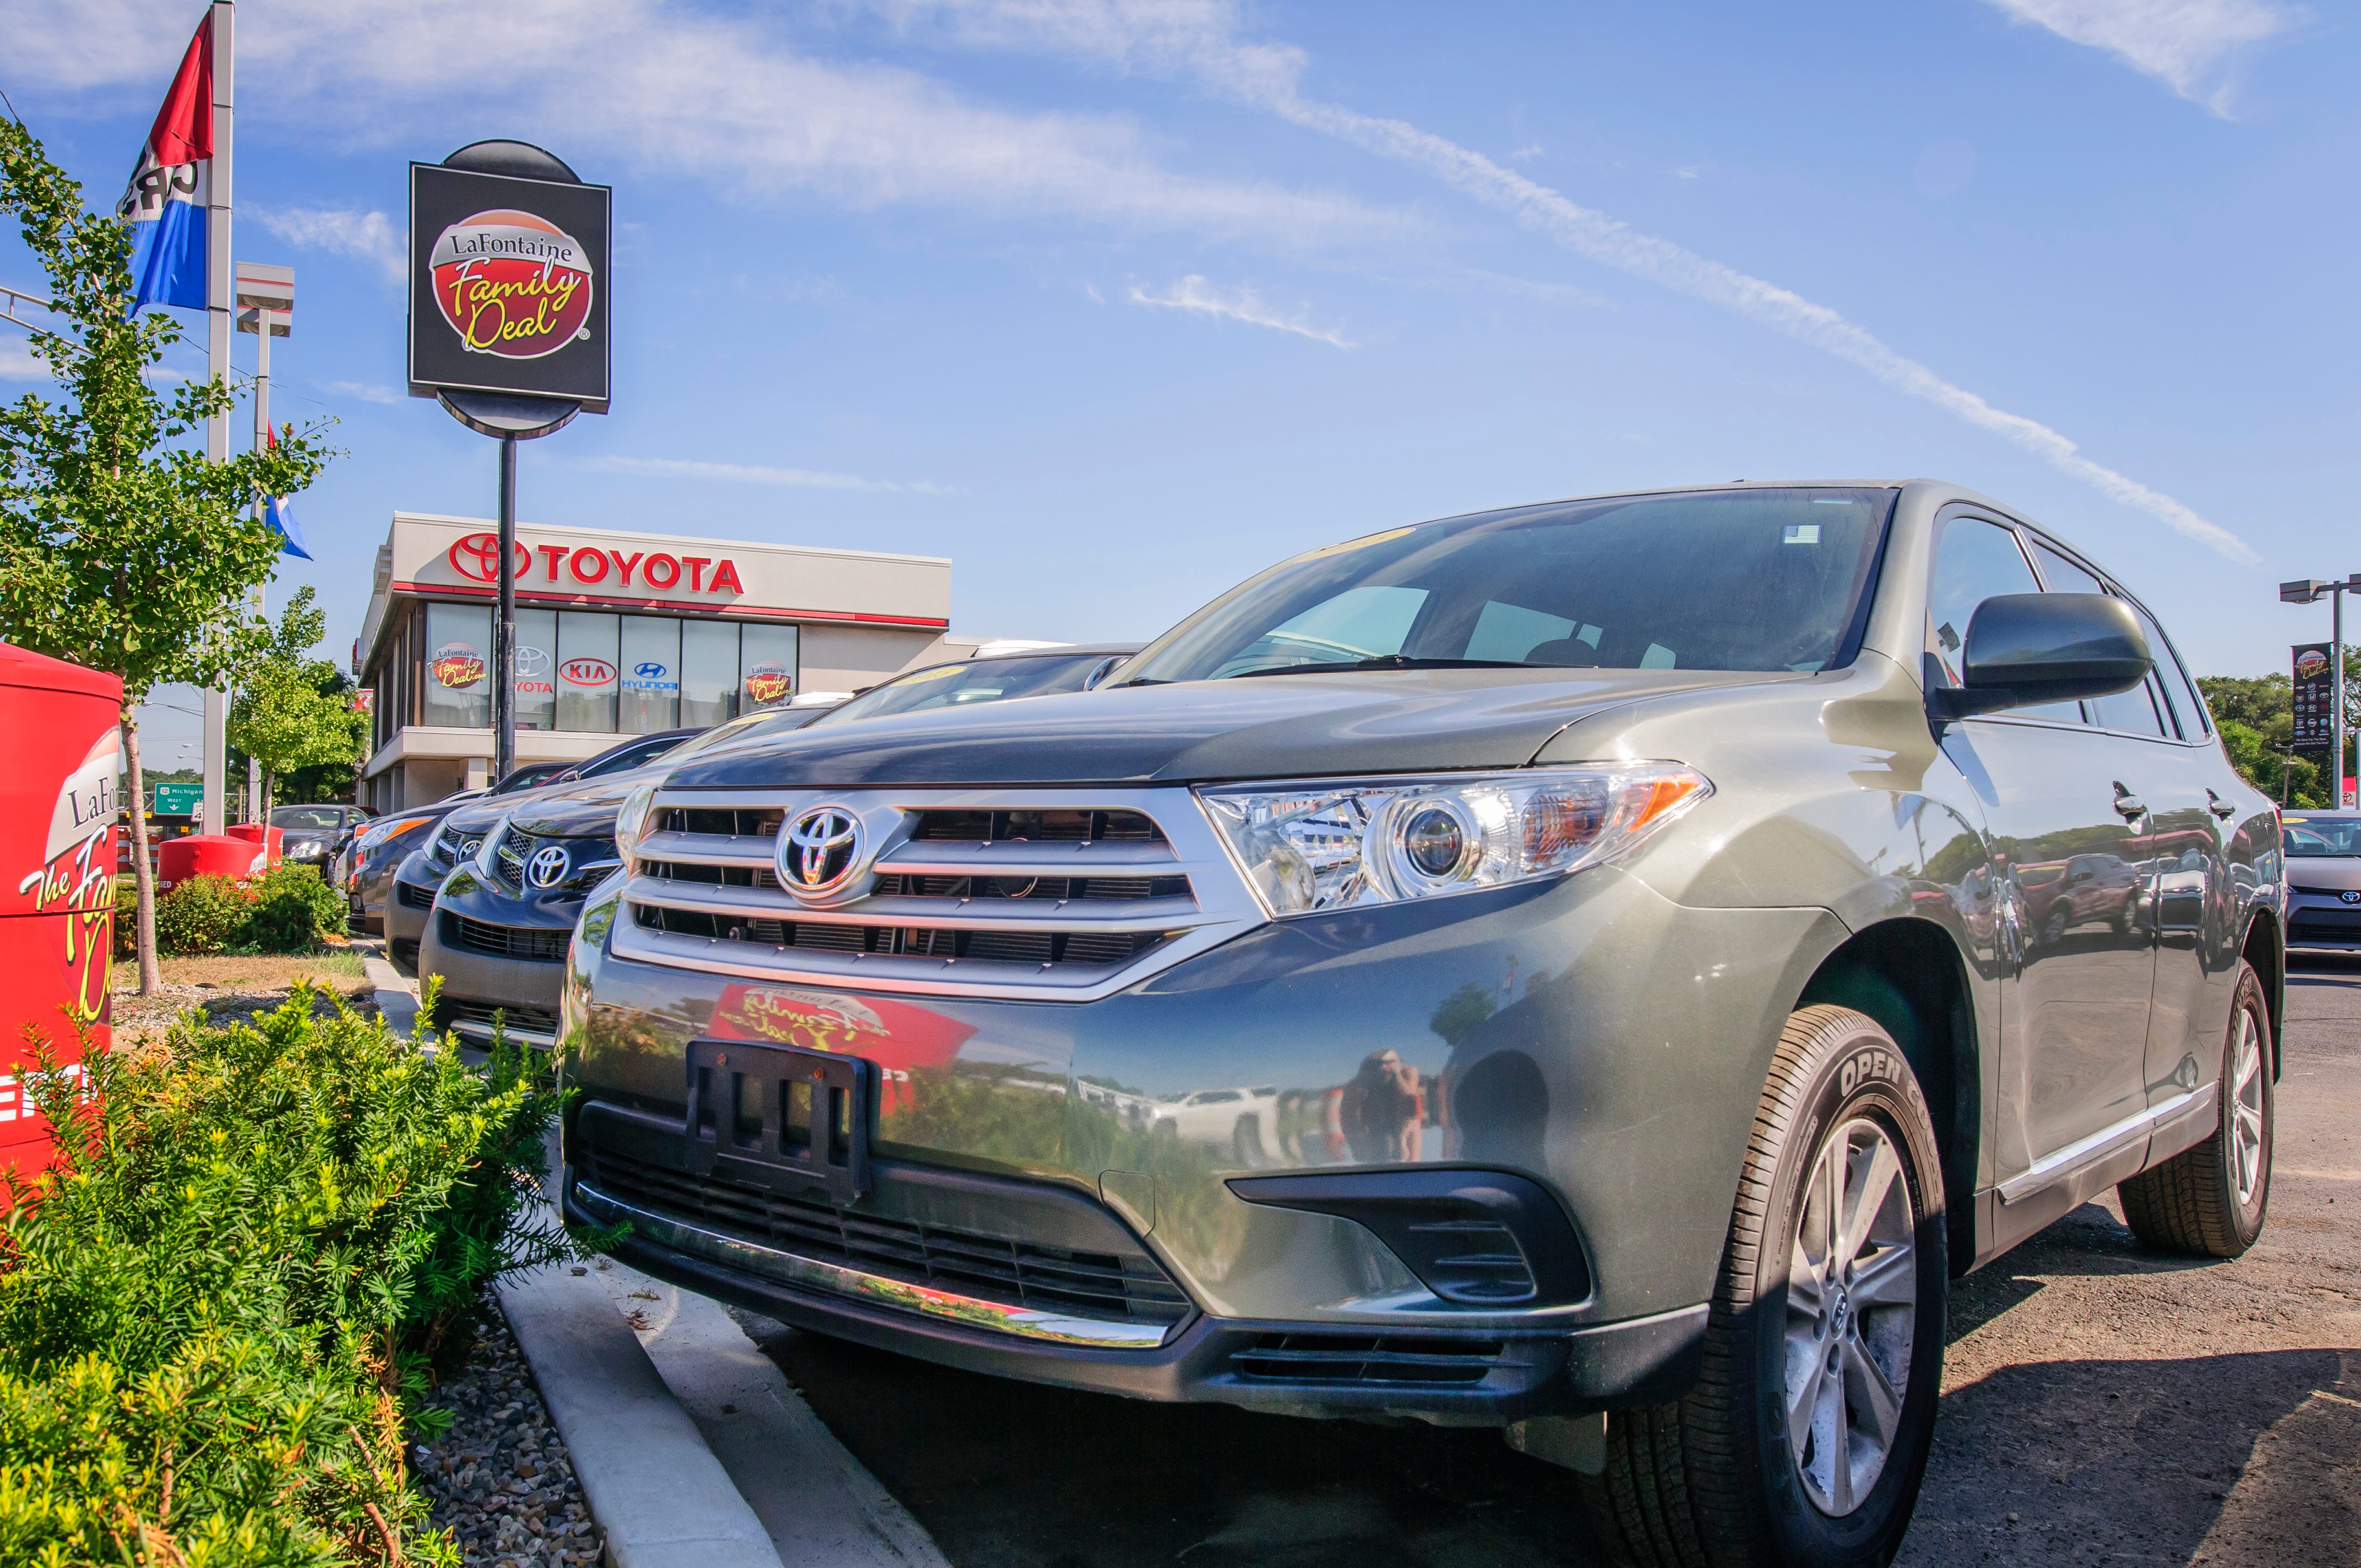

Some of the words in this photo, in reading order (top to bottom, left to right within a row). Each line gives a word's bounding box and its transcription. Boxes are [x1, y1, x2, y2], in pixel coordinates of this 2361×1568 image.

[450, 233, 572, 262] LaFontaine
[449, 254, 581, 317] Family
[465, 297, 557, 348] Deal
[538, 545, 744, 594] TOYOTA
[438, 649, 478, 657] LaFontaine
[438, 655, 481, 677] Family
[569, 665, 607, 679] KIA
[514, 682, 552, 693] YOTA
[622, 680, 678, 690] HYUNDAI
[750, 672, 788, 692] Family
[19, 864, 70, 911] The
[1841, 1052, 1901, 1097] OPEN
